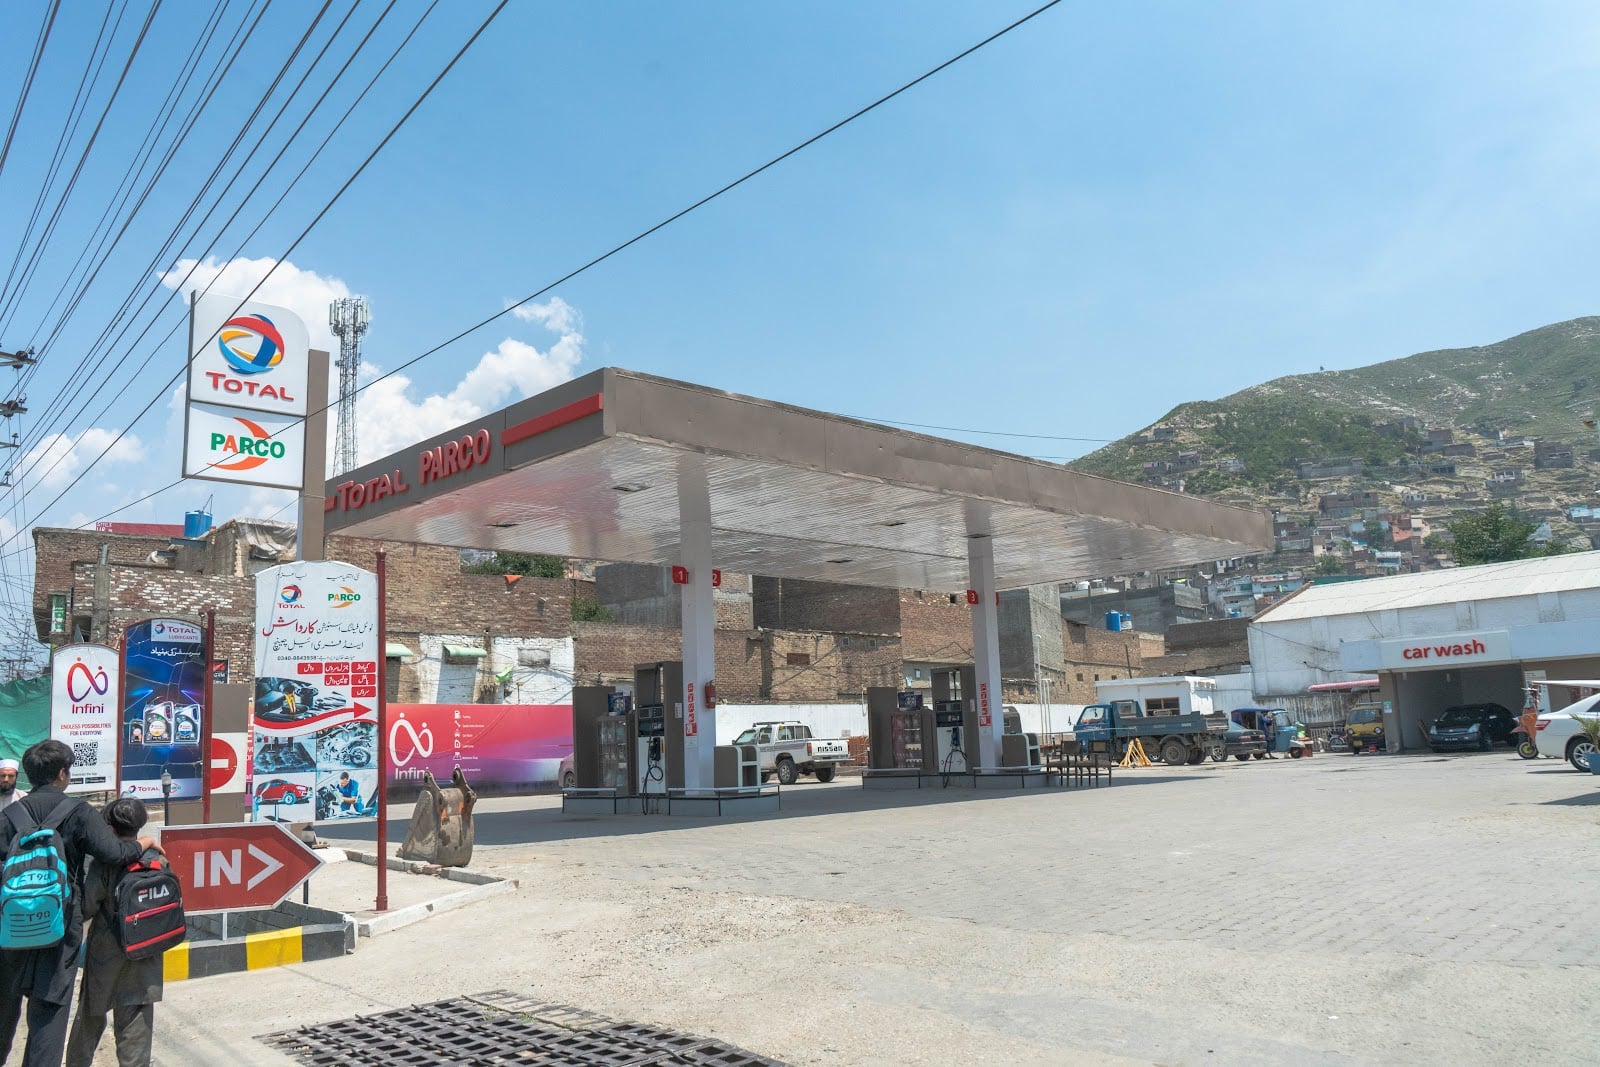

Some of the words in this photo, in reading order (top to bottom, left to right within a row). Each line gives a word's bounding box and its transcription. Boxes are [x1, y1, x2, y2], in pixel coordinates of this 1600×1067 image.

[205, 371, 294, 402] TOTAL
[210, 432, 285, 459] PARCO
[337, 469, 409, 511] TOTAL
[419, 428, 491, 485] PARCO
[678, 571, 683, 581] 1
[712, 573, 717, 583] 2
[328, 593, 361, 601] PARCO
[1402, 646, 1431, 660] car
[1433, 639, 1486, 657] wash
[71, 703, 104, 714] Infini
[395, 766, 429, 780] Infin
[138, 884, 170, 903] FILA
